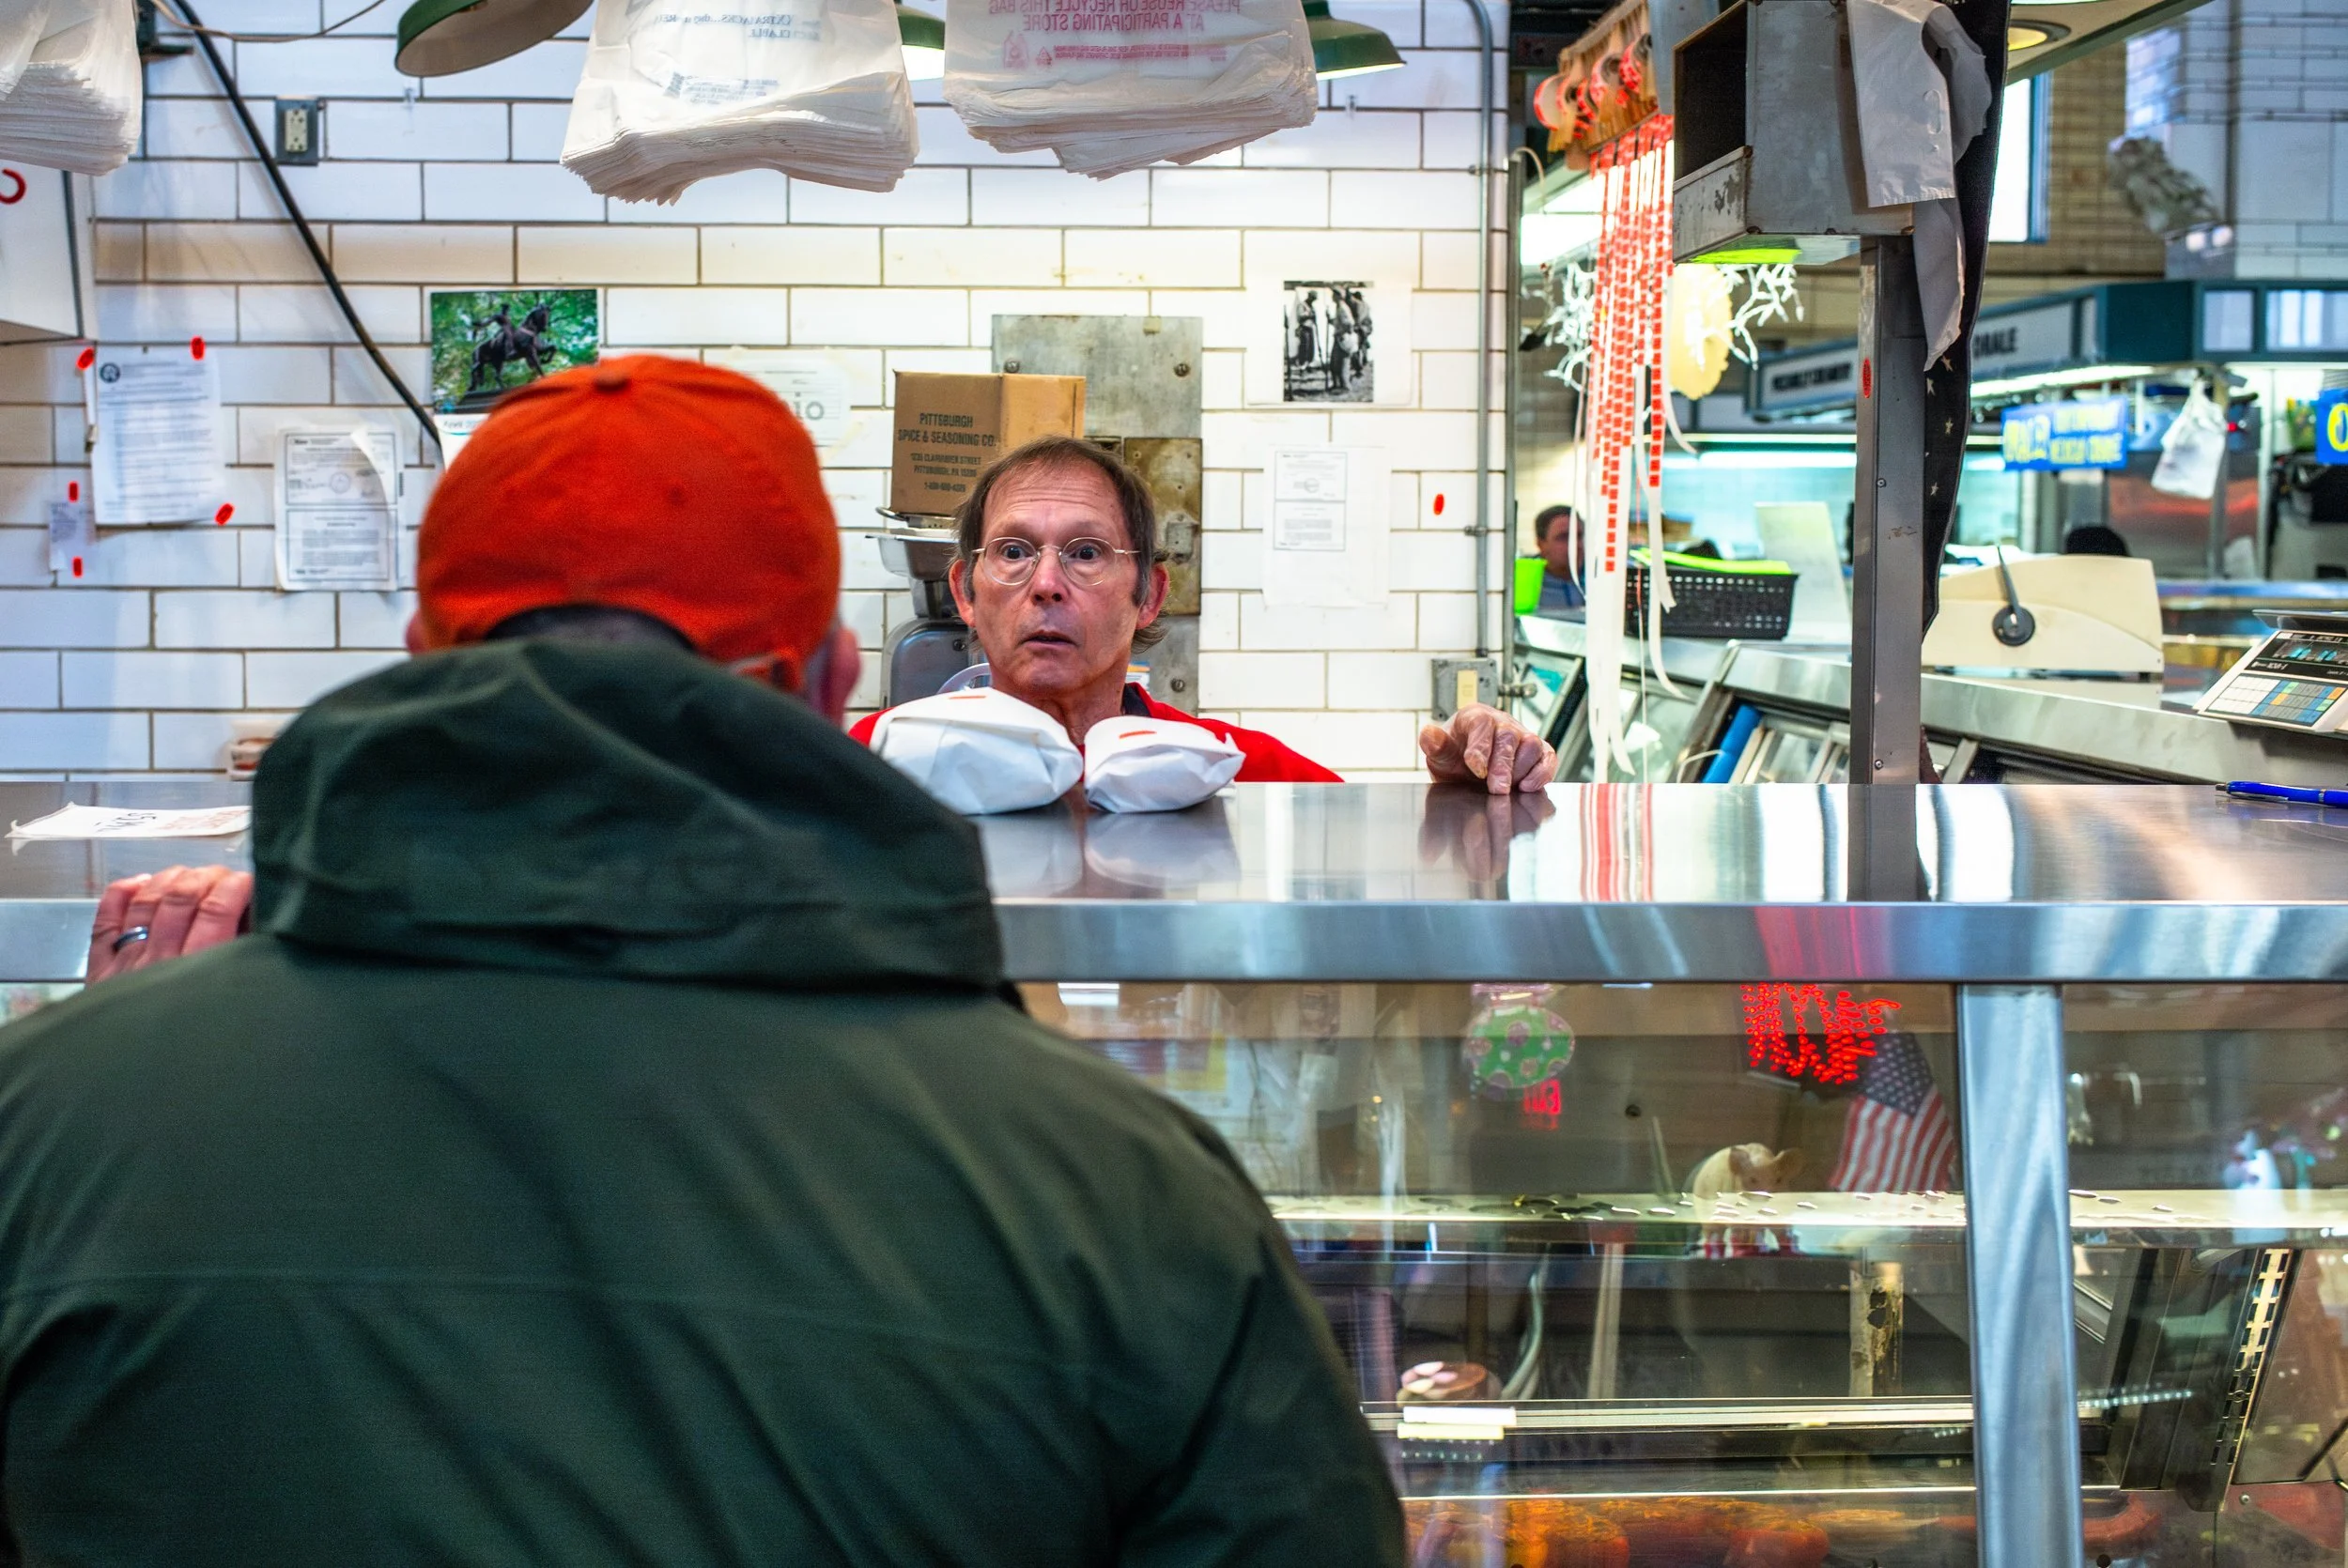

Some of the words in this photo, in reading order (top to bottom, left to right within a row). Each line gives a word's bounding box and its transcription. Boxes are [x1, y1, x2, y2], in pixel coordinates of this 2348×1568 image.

[794, 392, 825, 421] io
[919, 413, 974, 428] PITTSBURGH
[898, 429, 920, 443] SPICE
[922, 430, 929, 442] &
[931, 431, 980, 446] SEASONING
[981, 435, 996, 447] CO.
